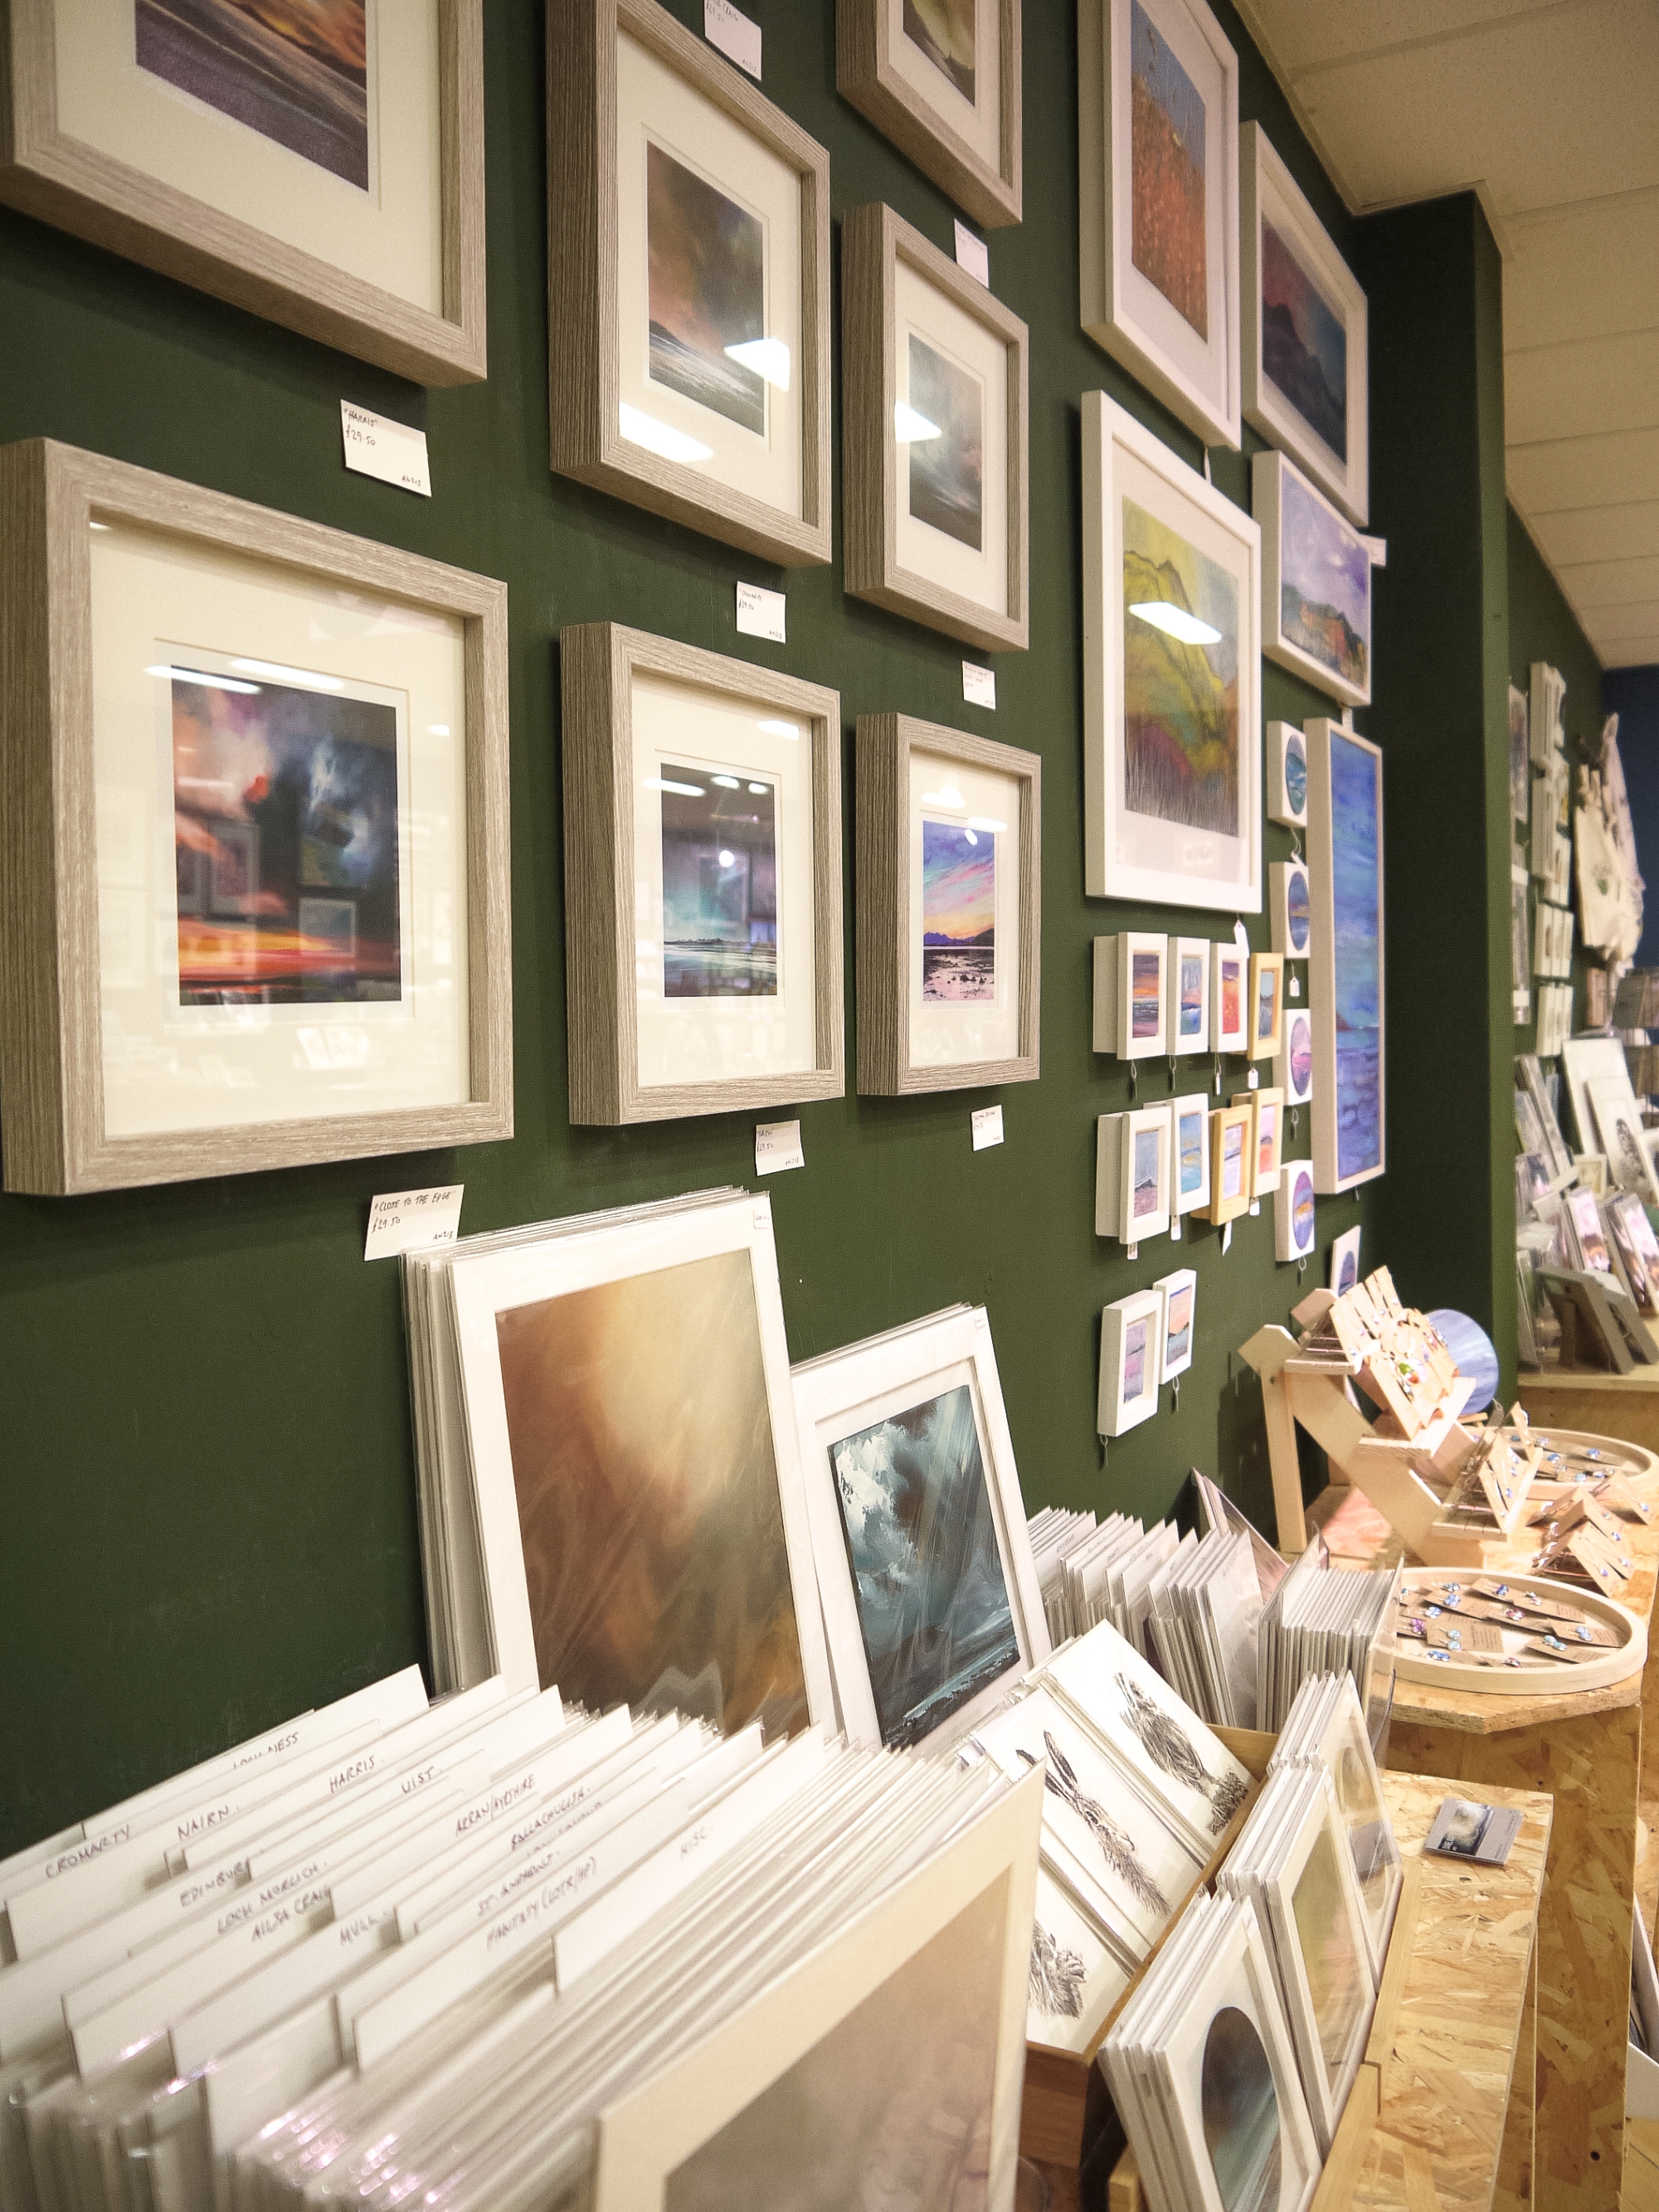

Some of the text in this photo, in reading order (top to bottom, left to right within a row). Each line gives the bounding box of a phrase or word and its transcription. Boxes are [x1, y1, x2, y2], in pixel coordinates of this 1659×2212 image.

[403, 1197, 412, 1208] TO
[415, 1194, 430, 1205] THE
[45, 1824, 131, 1879] CROMARTY
[217, 1903, 254, 1935] LOCH
[251, 1908, 291, 1943] AILSA
